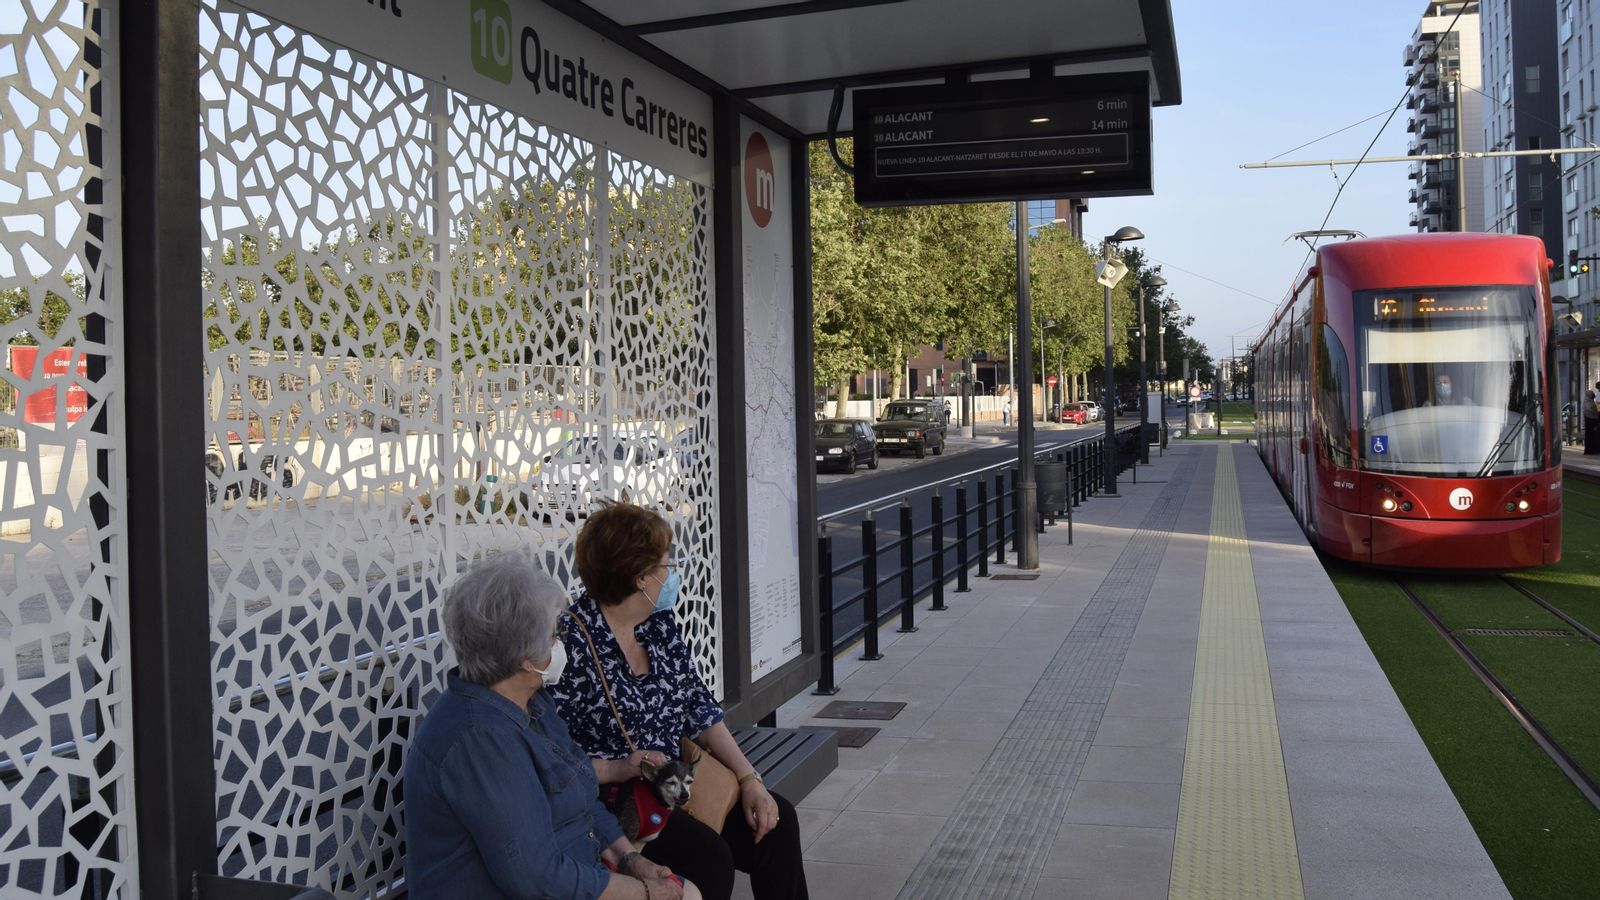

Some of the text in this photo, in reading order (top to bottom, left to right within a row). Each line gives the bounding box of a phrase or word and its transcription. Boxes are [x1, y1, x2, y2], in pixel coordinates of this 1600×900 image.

[473, 7, 708, 159] 10 Quatre Carreres
[1097, 99, 1128, 110] 6 min
[884, 111, 934, 123] ALACANT
[1091, 118, 1128, 130] 14 min
[885, 130, 934, 142] ALACANT
[877, 158, 898, 166] NUEVA
[927, 153, 987, 163] ALACANT-NATZARET
[988, 151, 1010, 160] DESDE
[1038, 149, 1057, 157] MAYO
[756, 167, 774, 212] m
[1458, 496, 1472, 506] m
